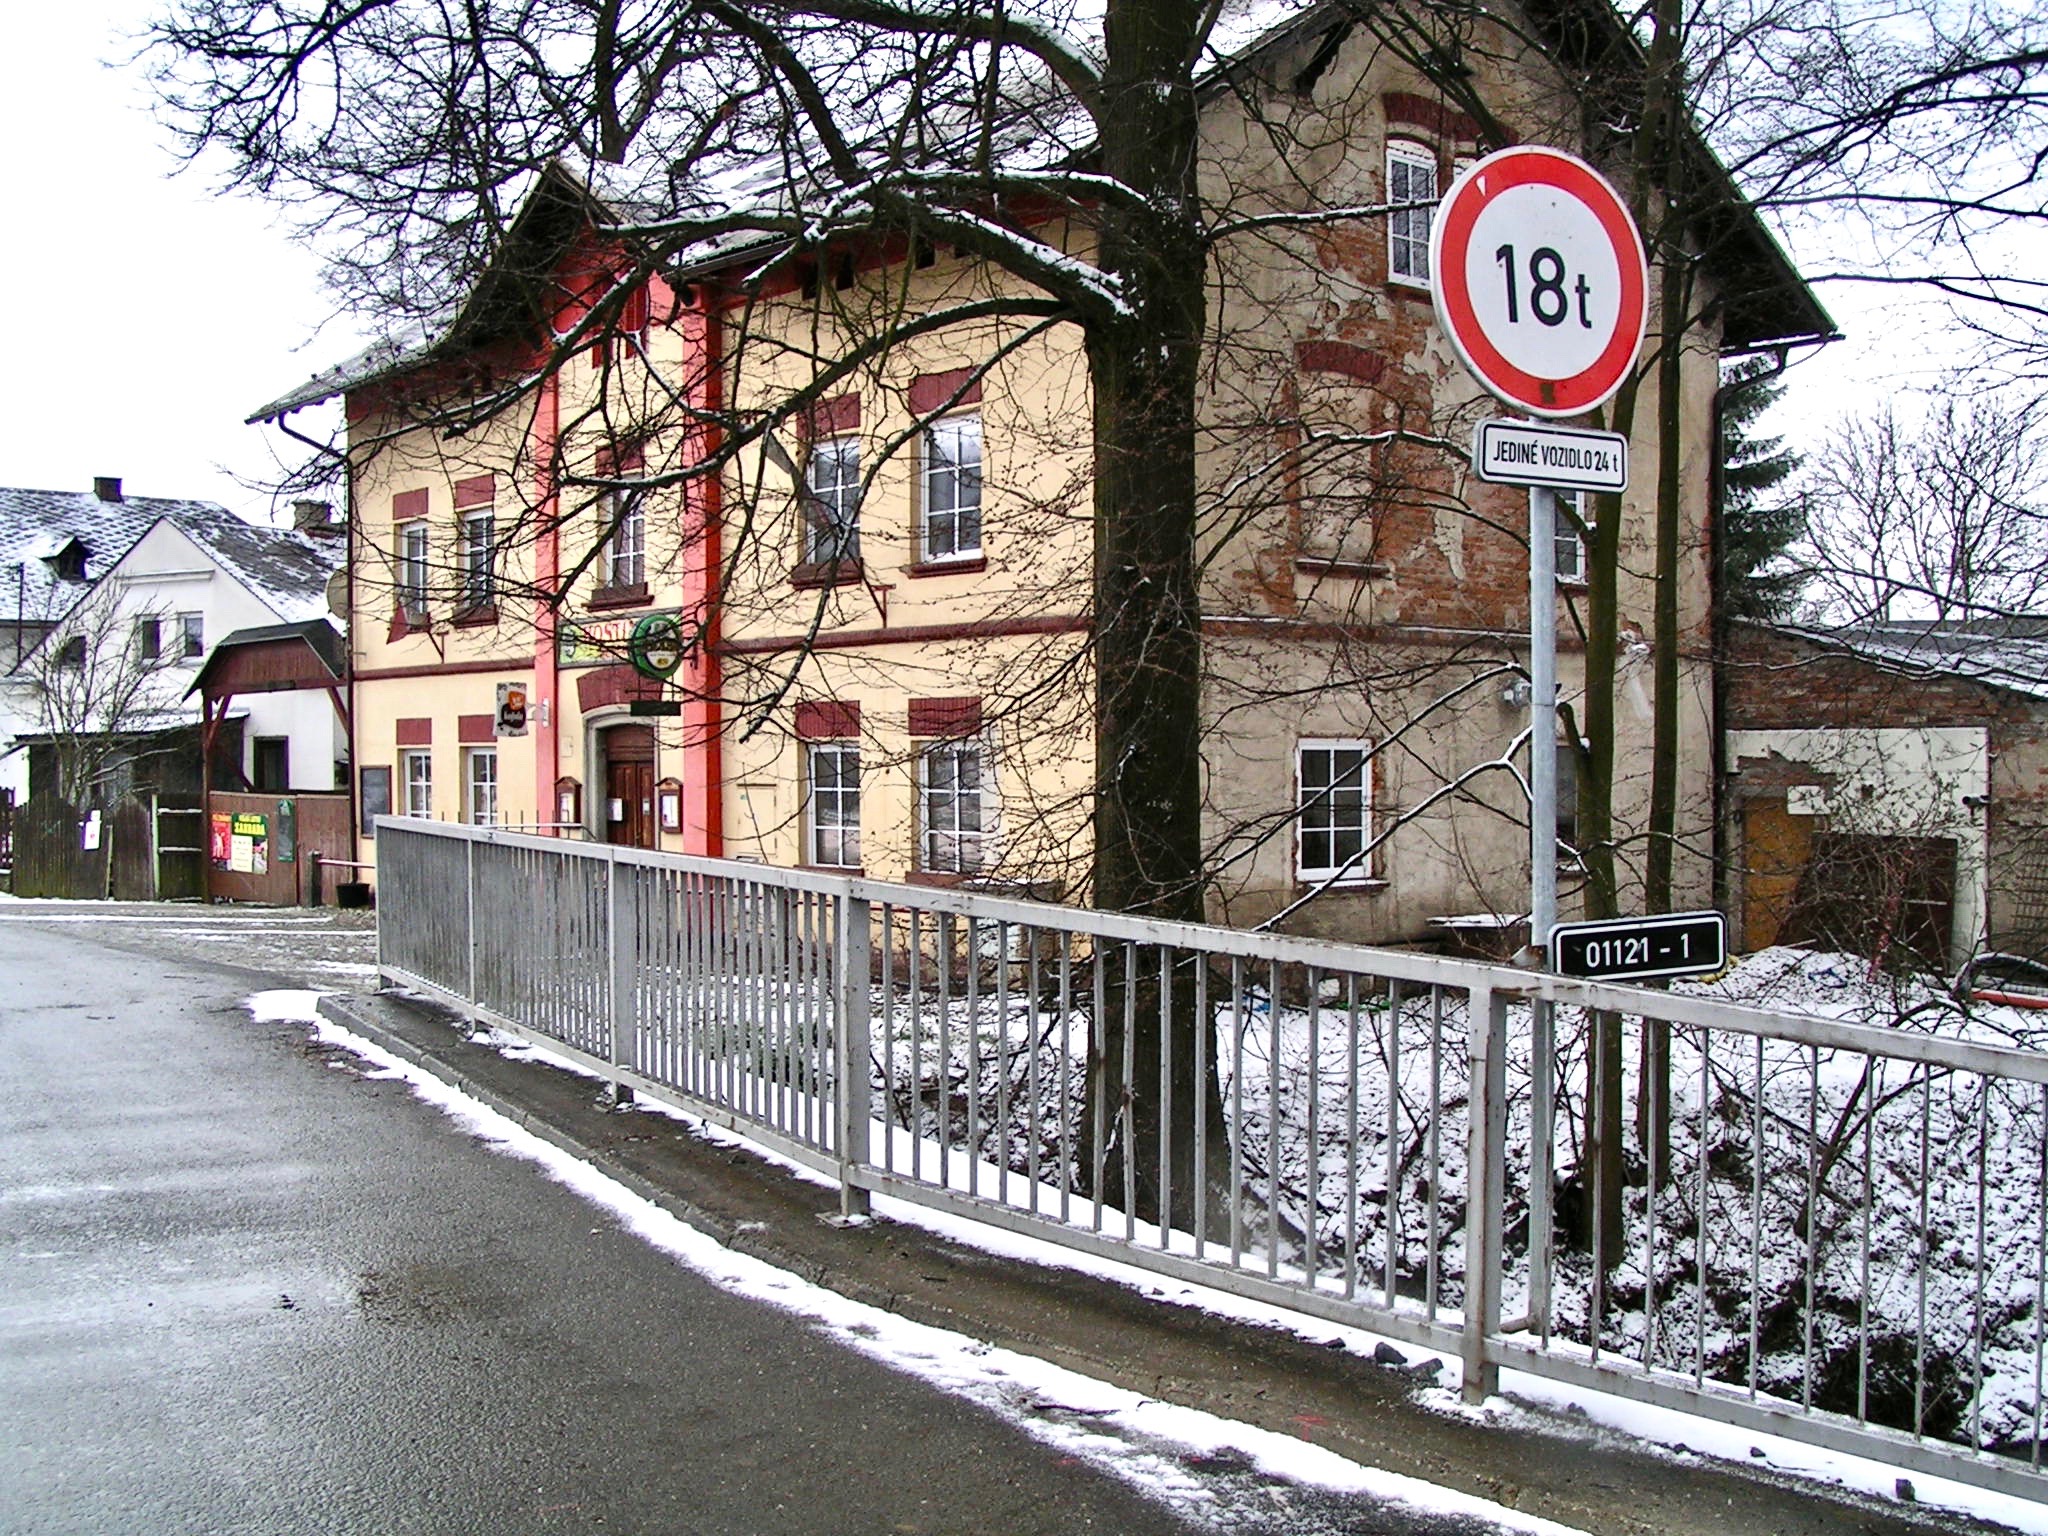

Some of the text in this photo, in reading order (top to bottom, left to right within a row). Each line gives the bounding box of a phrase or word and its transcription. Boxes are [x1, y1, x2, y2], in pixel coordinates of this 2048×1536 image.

[1493, 440, 1618, 472] JEDINÉ VOZIDLO 24 t
[1586, 937, 1649, 968] 01121
[1680, 933, 1689, 959] 1
